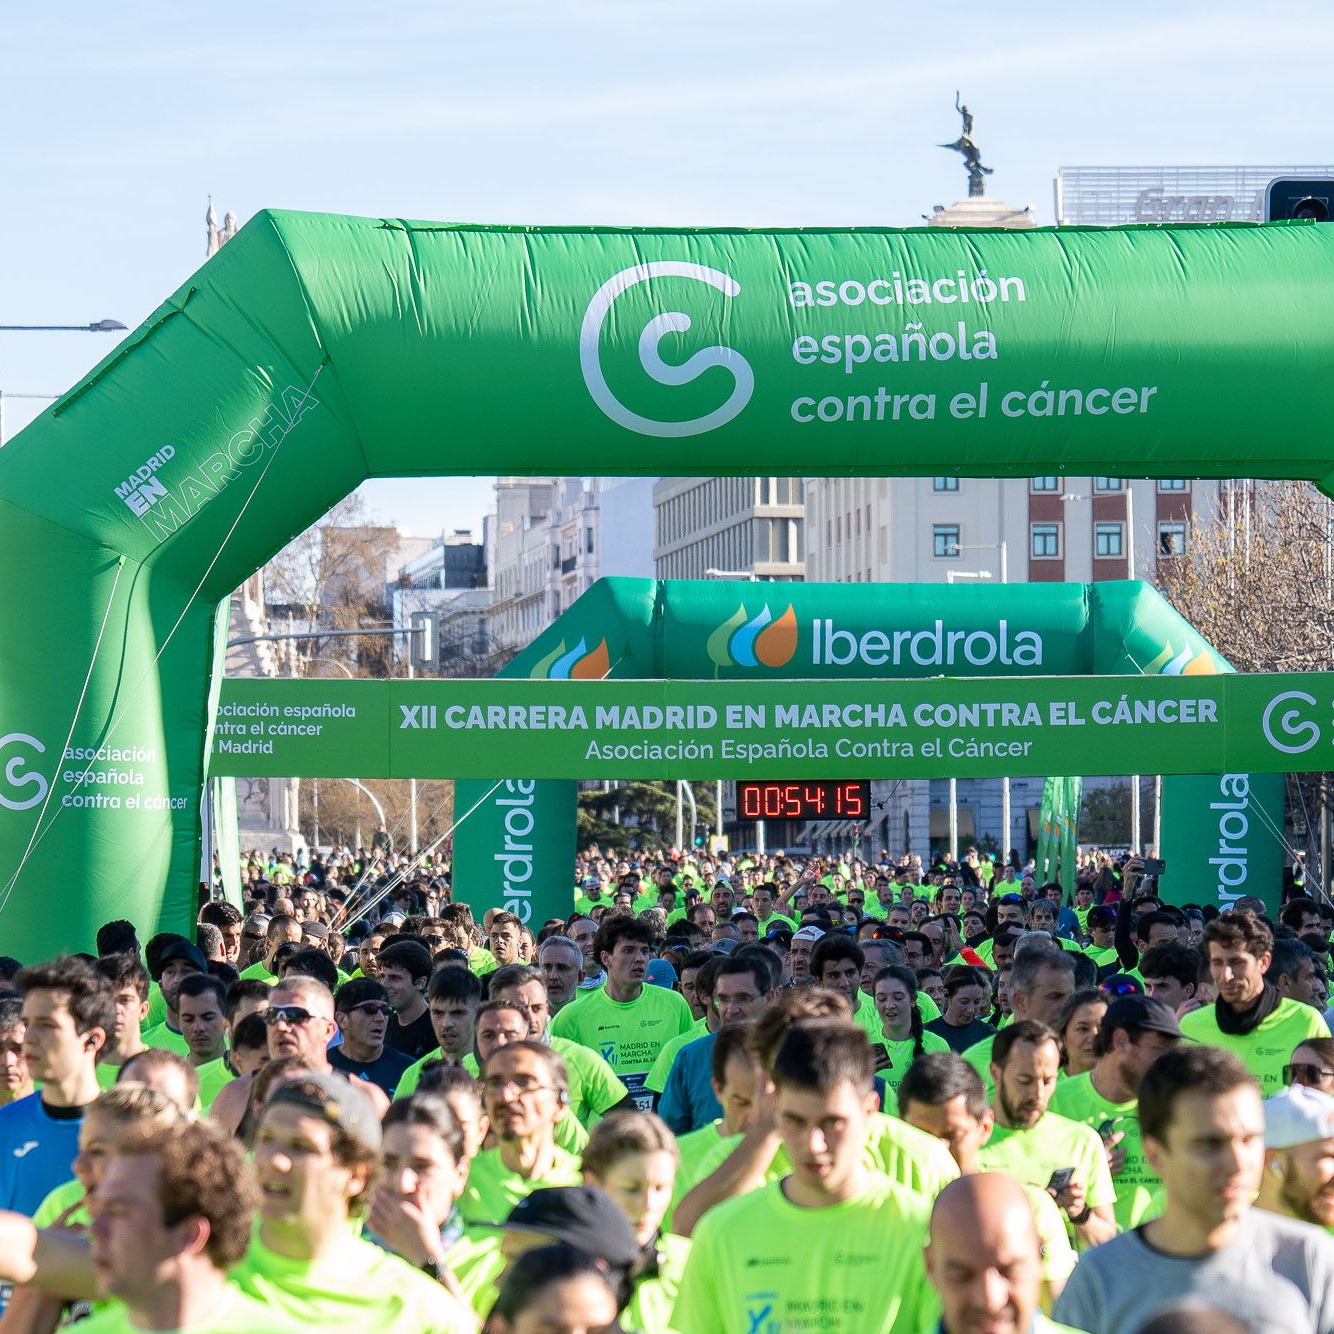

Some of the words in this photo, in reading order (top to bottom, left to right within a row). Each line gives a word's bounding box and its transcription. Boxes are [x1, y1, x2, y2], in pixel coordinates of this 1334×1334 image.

[789, 270, 1027, 307] asociación
[792, 321, 998, 373] española
[790, 387, 936, 422] contra
[949, 382, 988, 419] el
[1001, 380, 1158, 416] cáncer
[113, 444, 176, 500] MADRID
[139, 385, 320, 543] MARCHA
[124, 475, 168, 518] EN
[812, 619, 1043, 666] Iberdrola
[214, 722, 246, 735] ntra
[250, 721, 264, 735] el
[268, 721, 323, 736] cáncer
[216, 703, 280, 717] ociación
[283, 703, 356, 720] española
[399, 705, 437, 729] XII
[444, 705, 588, 730] CARRERA
[595, 705, 717, 729] MADRID
[725, 704, 766, 728] EN
[775, 703, 908, 728] MARCHA
[913, 701, 1043, 727] CONTRA
[1049, 701, 1085, 726] EL
[1091, 694, 1219, 725] CÁNCER
[64, 744, 157, 763] asociación
[218, 740, 274, 754] Madrid
[585, 740, 714, 760] Asociación
[721, 738, 828, 763] Española
[835, 738, 914, 758] Contra
[920, 738, 943, 757] el
[948, 737, 1033, 758] Cáncer
[63, 769, 145, 788] española
[62, 792, 121, 809] contra
[125, 793, 140, 810] el
[144, 792, 188, 810] cáncer
[744, 785, 861, 817] 00:54:15
[494, 779, 536, 924] erdrola
[1208, 773, 1250, 914] rdrola
[620, 1042, 648, 1050] MADRID
[620, 1049, 652, 1059] MARCHA
